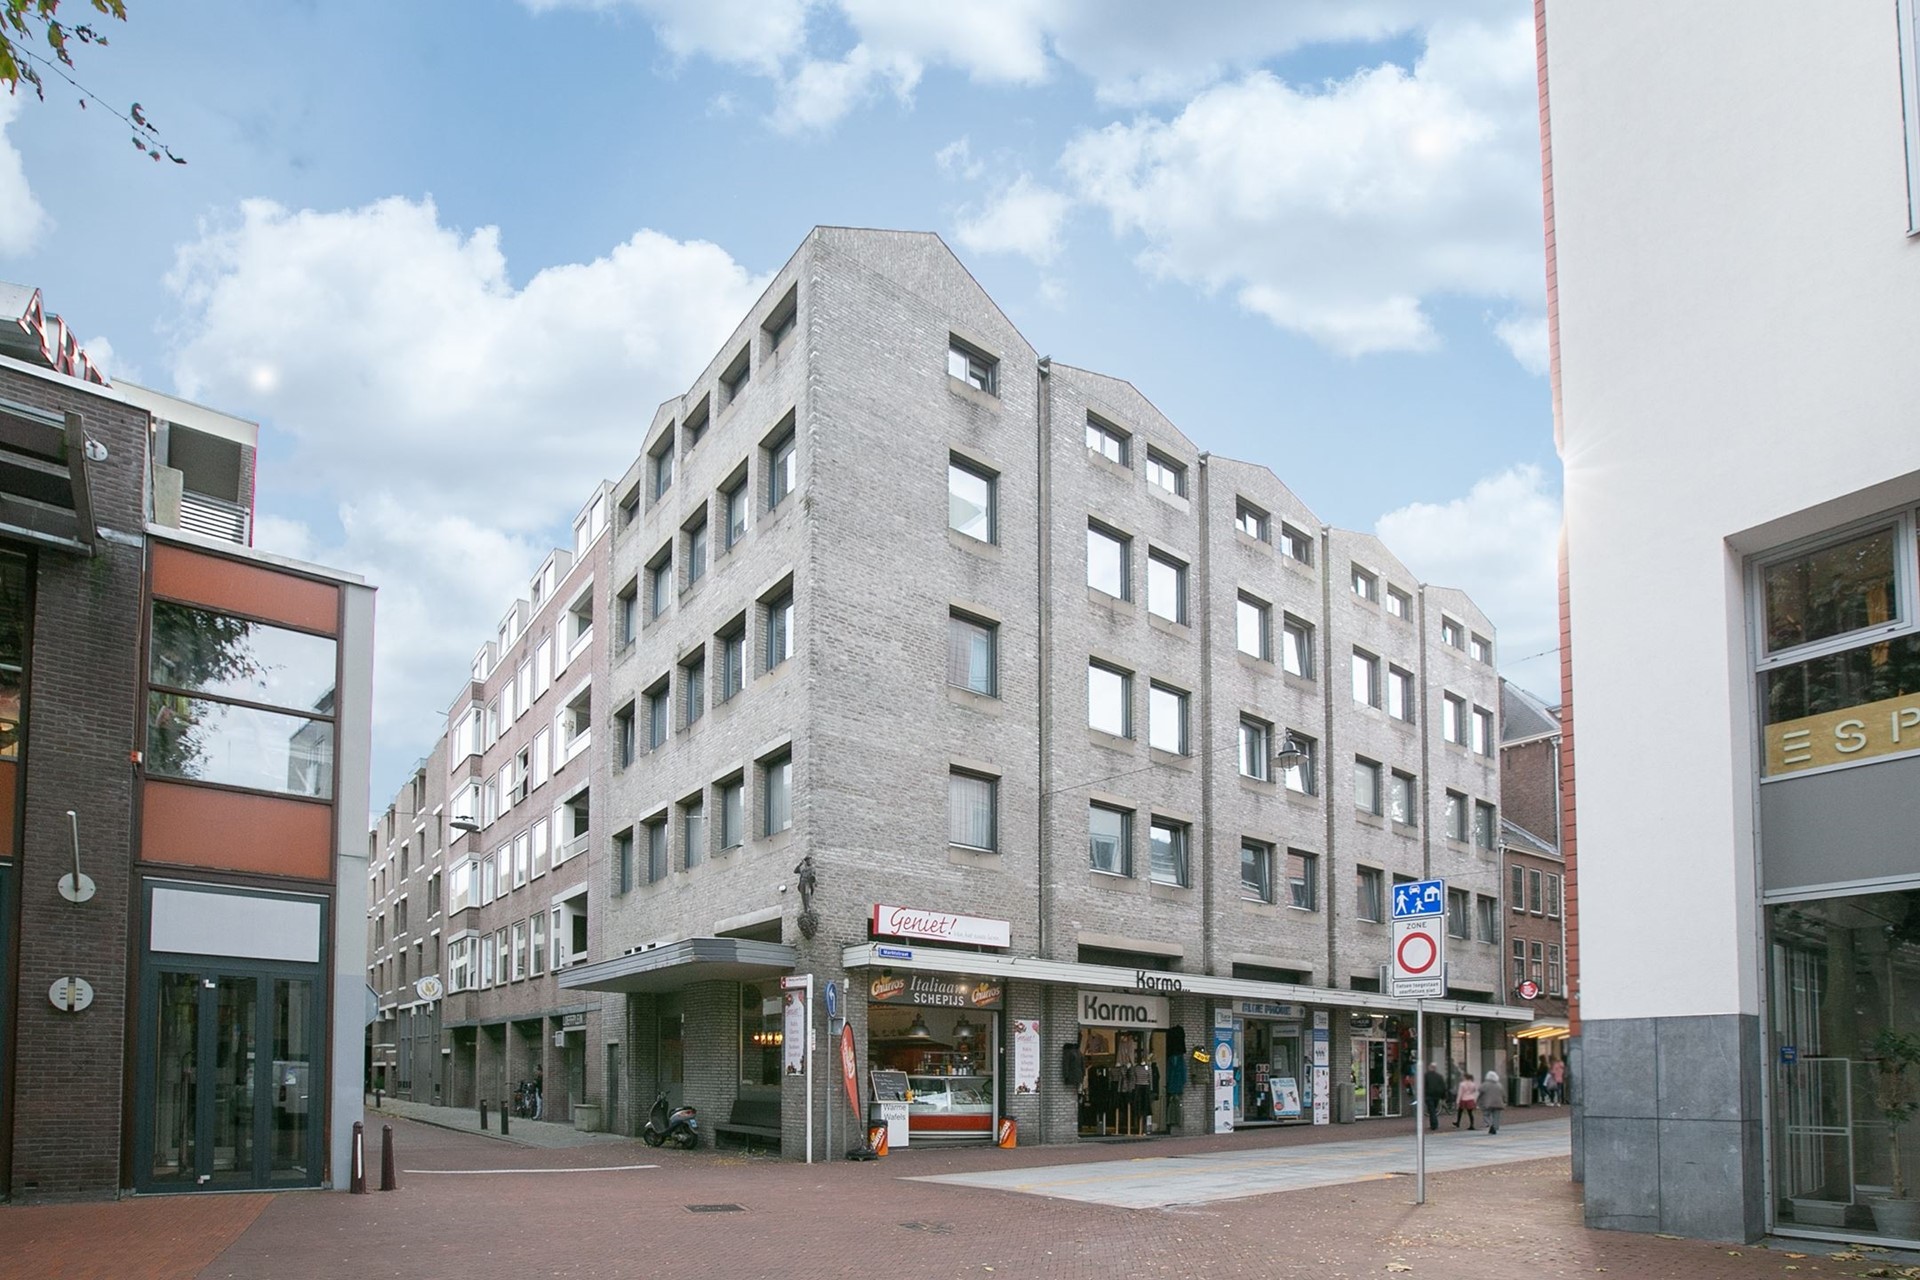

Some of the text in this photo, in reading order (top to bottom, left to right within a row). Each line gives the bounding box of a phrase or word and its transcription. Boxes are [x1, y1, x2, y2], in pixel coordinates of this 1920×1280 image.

[890, 907, 958, 935] Geniet!
[871, 979, 905, 996] Churros
[971, 987, 1000, 1003] Churros
[913, 992, 965, 1006] SCHEPIJS
[883, 1103, 907, 1111] Warme
